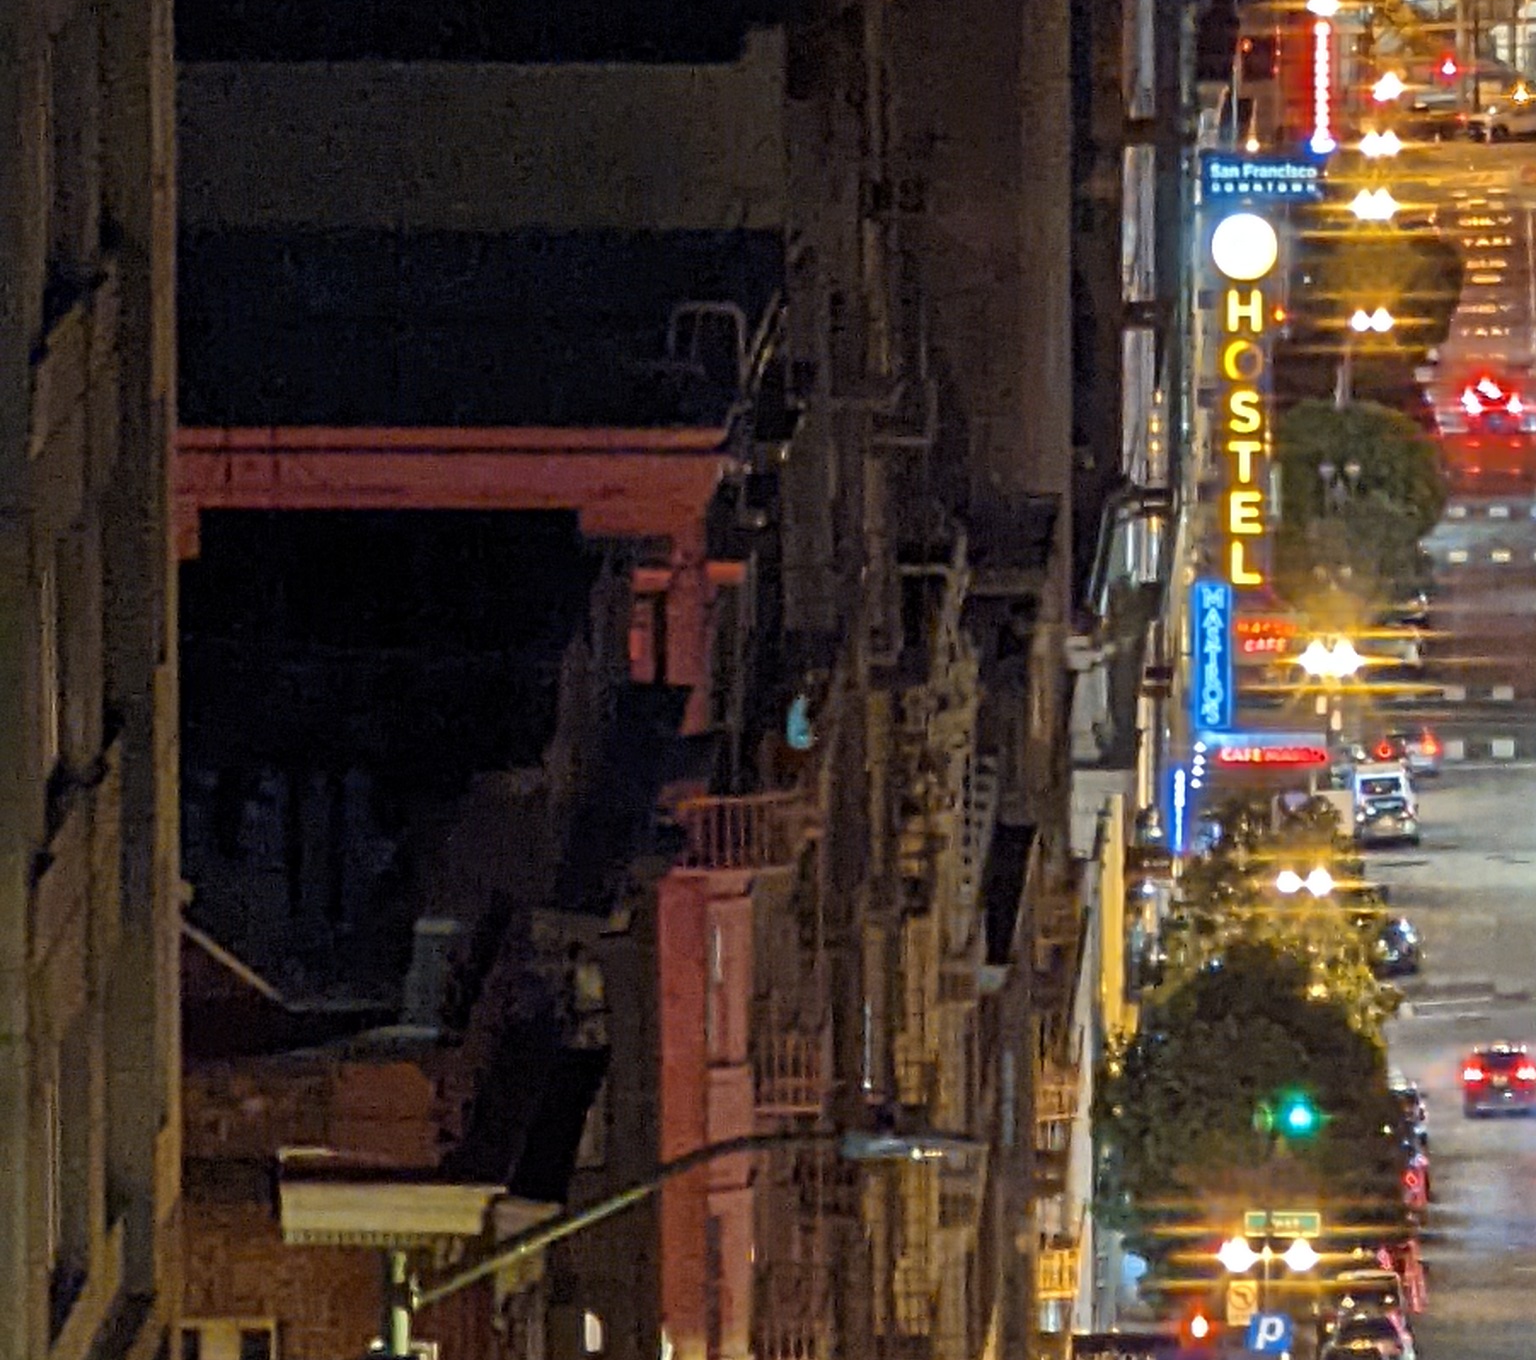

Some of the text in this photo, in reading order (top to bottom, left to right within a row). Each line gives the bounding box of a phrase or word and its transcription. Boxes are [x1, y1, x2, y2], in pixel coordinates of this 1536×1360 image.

[1210, 163, 1318, 179] San Francisco
[1224, 289, 1263, 584] HOSTEL
[1220, 747, 1262, 762] CAFE
